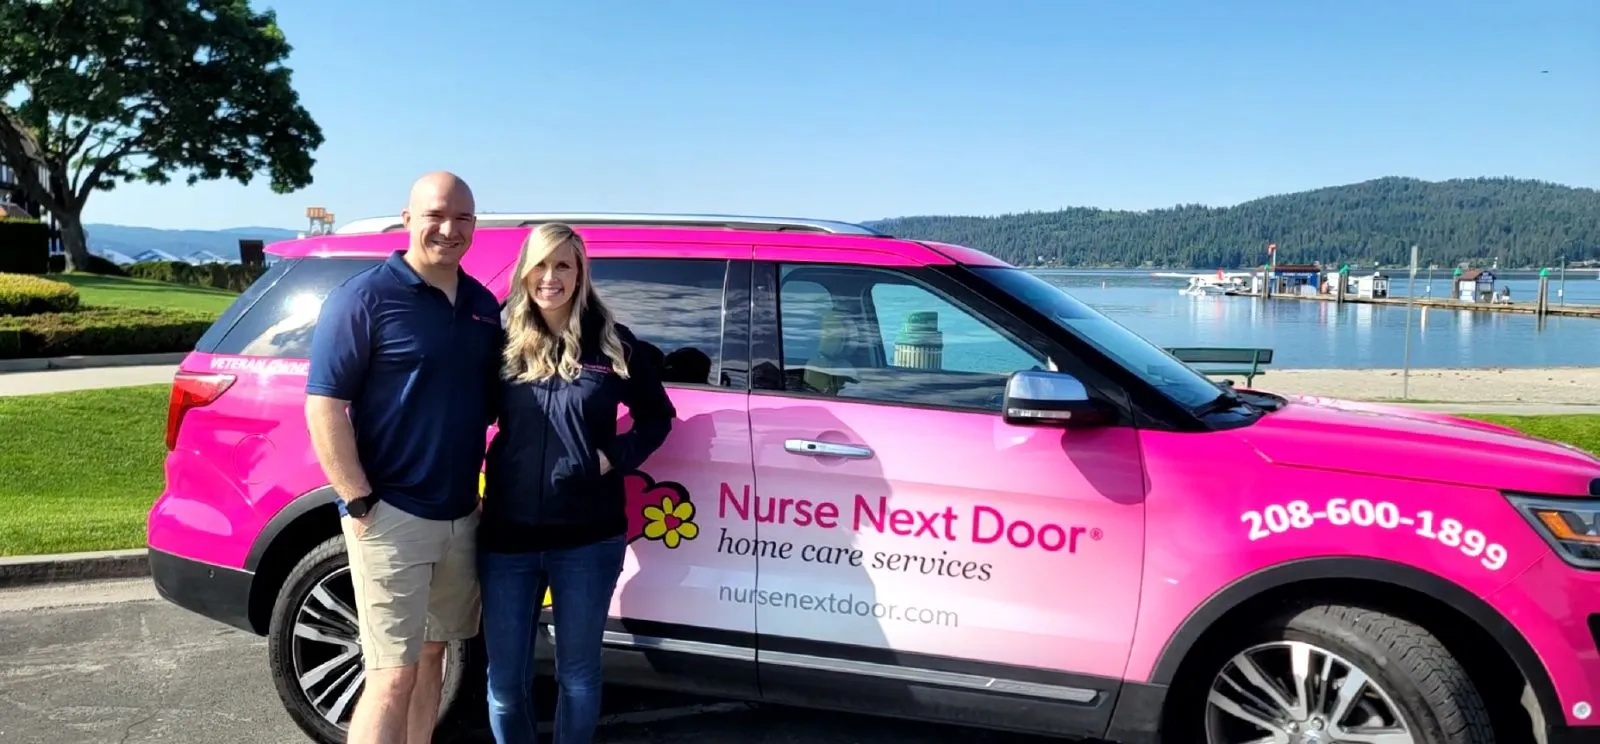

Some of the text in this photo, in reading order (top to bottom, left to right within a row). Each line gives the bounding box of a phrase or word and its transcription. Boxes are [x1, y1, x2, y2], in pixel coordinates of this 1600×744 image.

[211, 357, 264, 371] VETERAN
[718, 482, 838, 528] Nurse
[853, 495, 958, 541] Next
[1241, 498, 1508, 571] 208-600-1899
[717, 528, 993, 582] home care services
[719, 583, 959, 627] nursenextdoor.com
